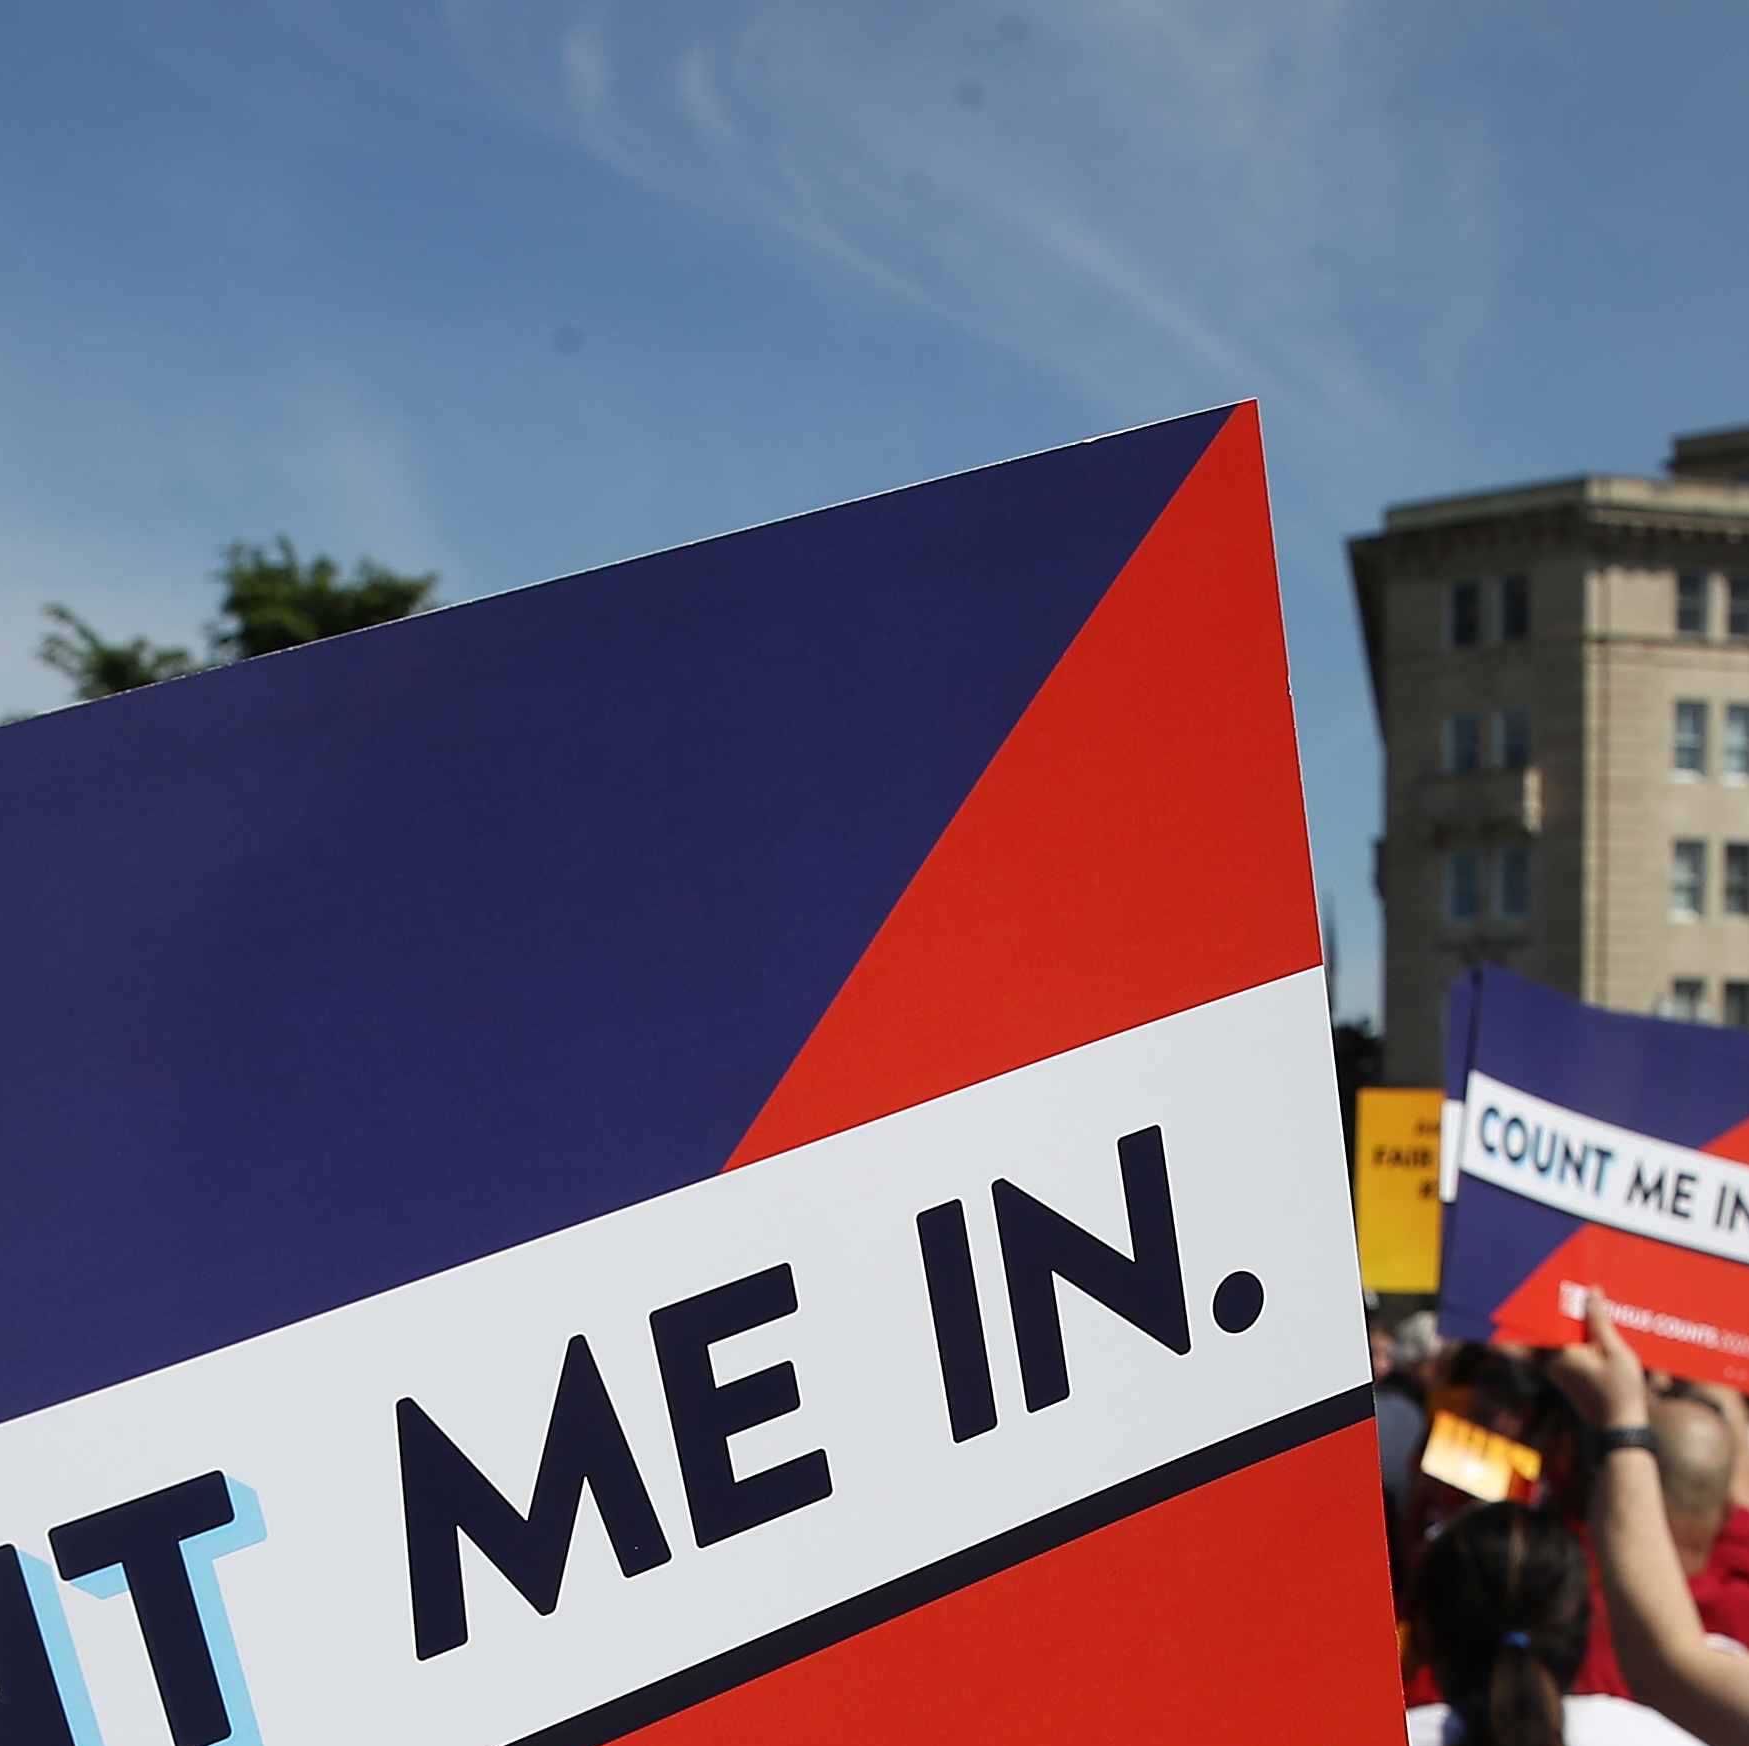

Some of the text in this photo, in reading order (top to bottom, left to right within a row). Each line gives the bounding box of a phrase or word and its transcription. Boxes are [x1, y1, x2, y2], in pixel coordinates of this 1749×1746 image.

[1479, 1106, 1615, 1196] COUNT
[1624, 1159, 1698, 1219] ME
[396, 1263, 833, 1661] ME
[916, 1125, 1264, 1443] IN.
